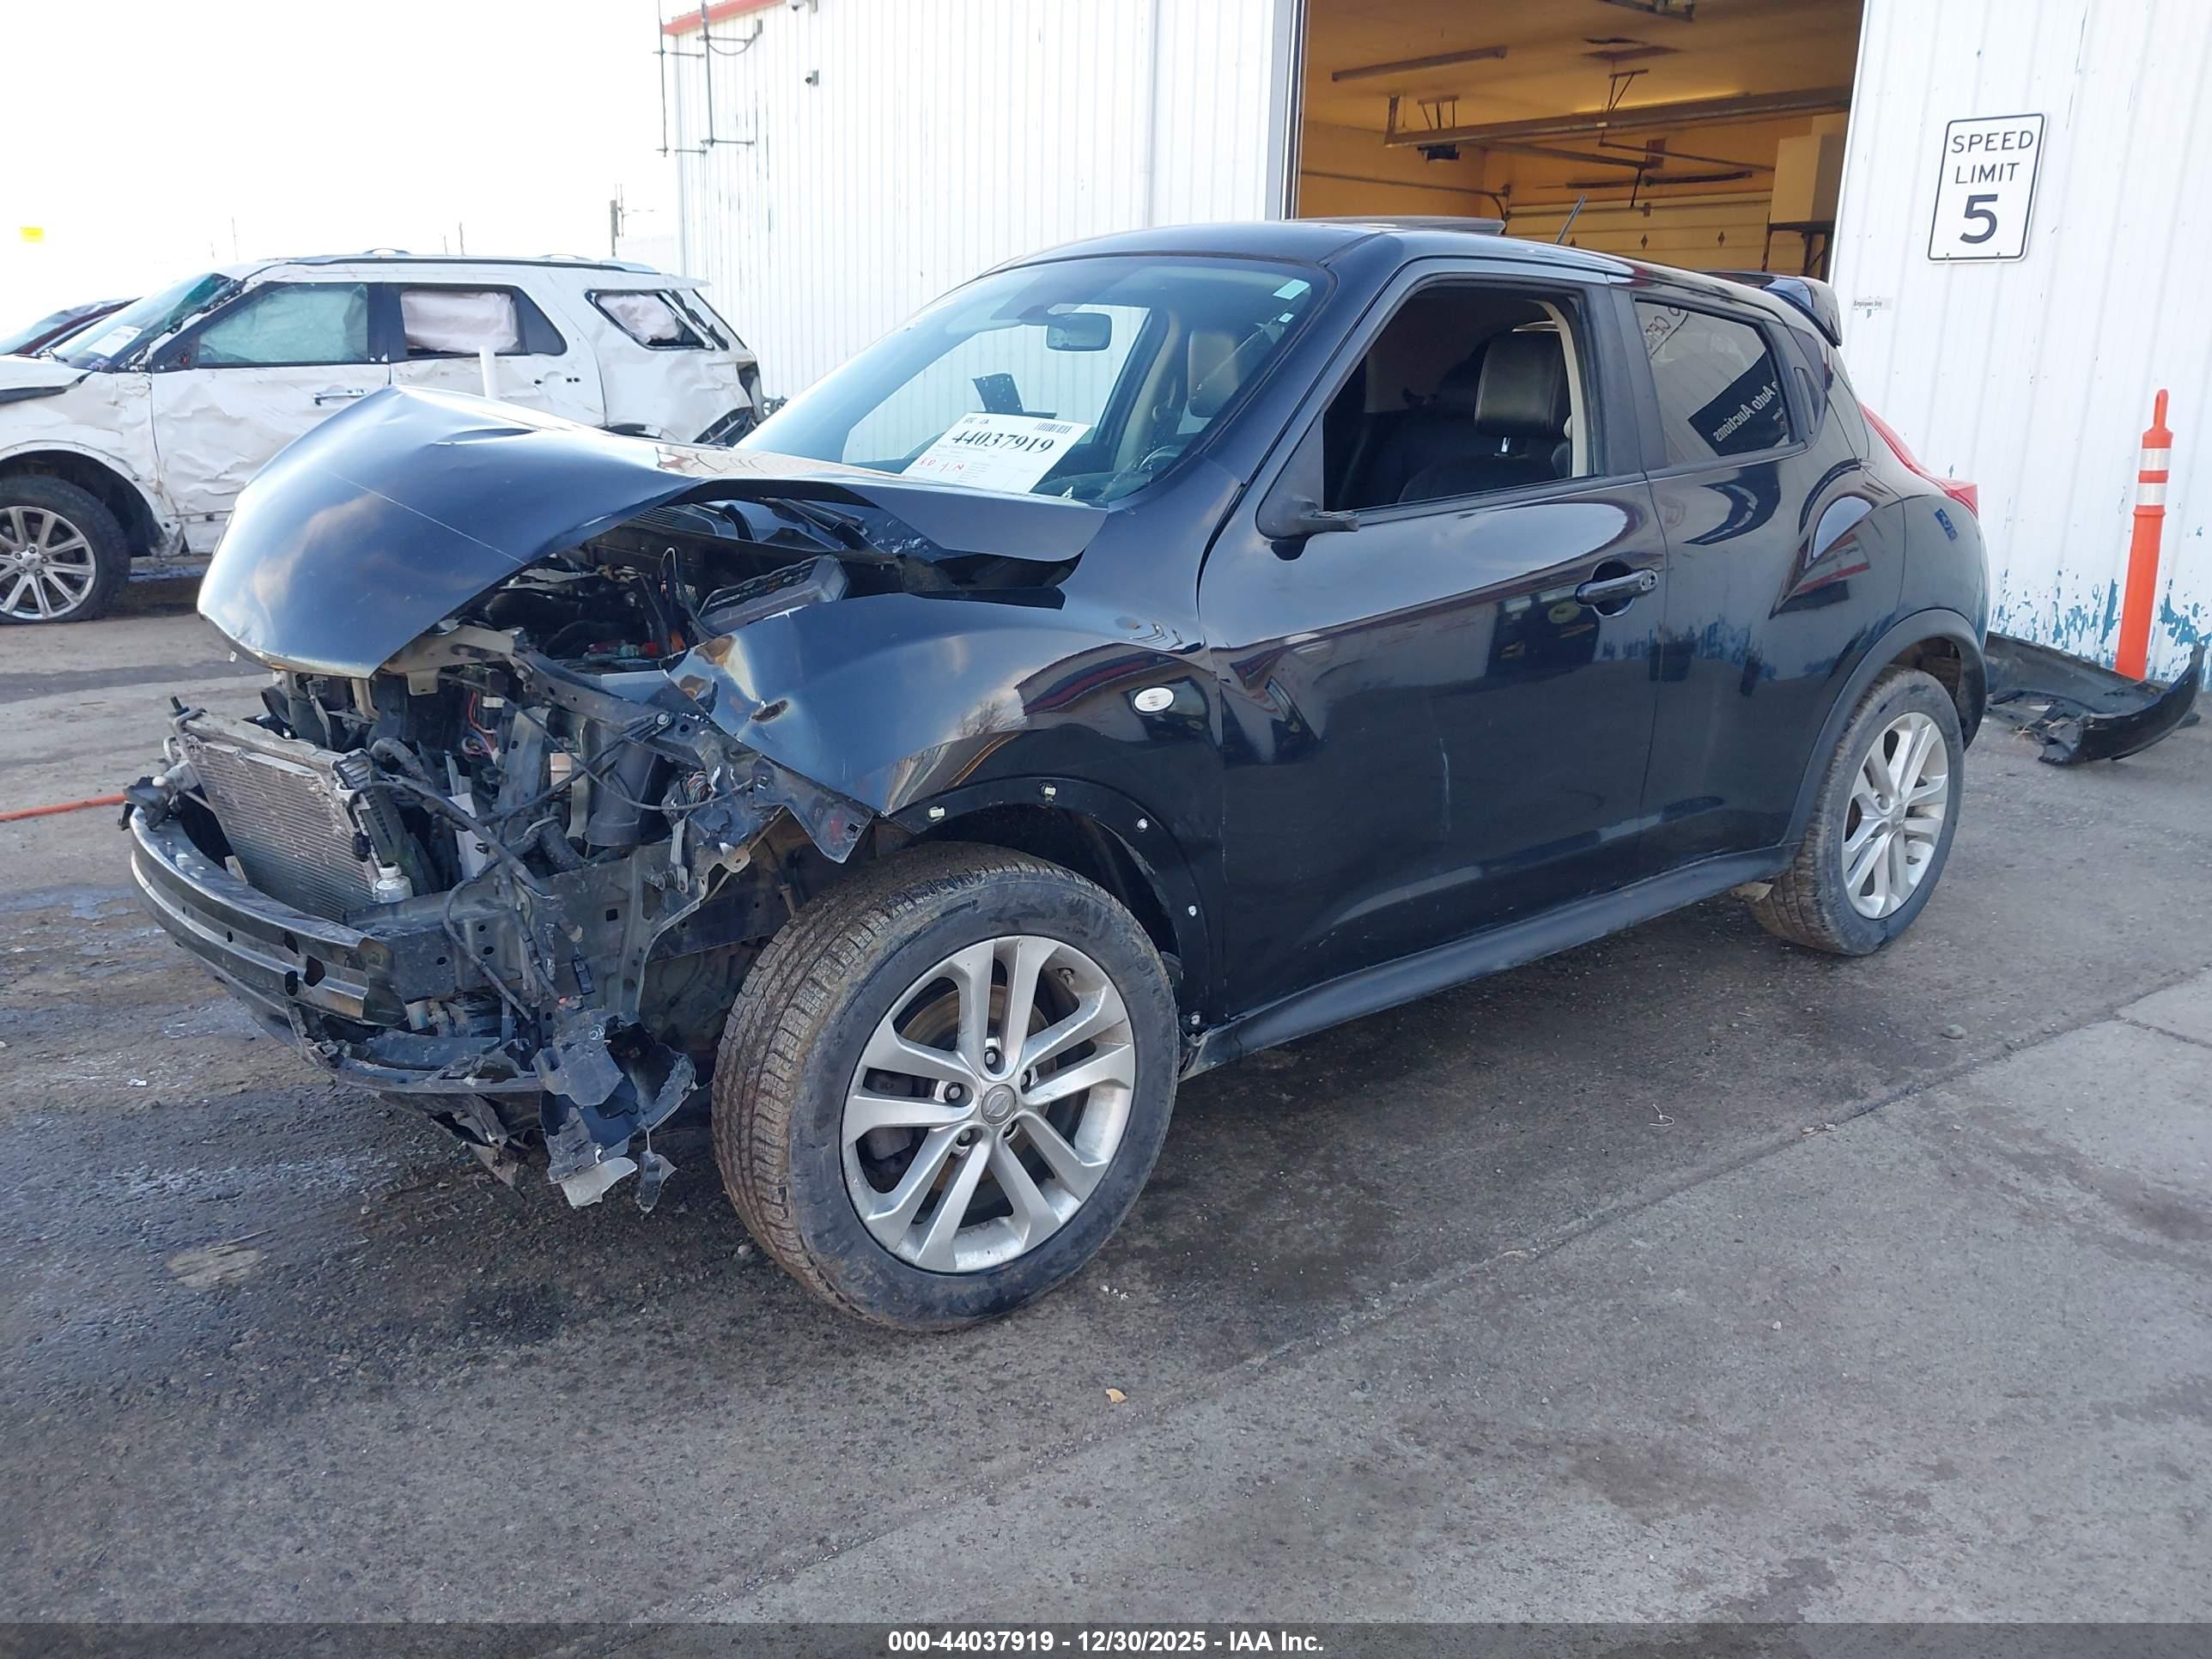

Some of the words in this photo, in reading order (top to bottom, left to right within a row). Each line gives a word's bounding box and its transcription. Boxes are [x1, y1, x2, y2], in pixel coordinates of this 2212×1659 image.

[1951, 131, 2033, 154] SPEED
[1954, 162, 2021, 184] LIMIT
[1960, 193, 1998, 244] 5
[951, 429, 1054, 453] 44037919
